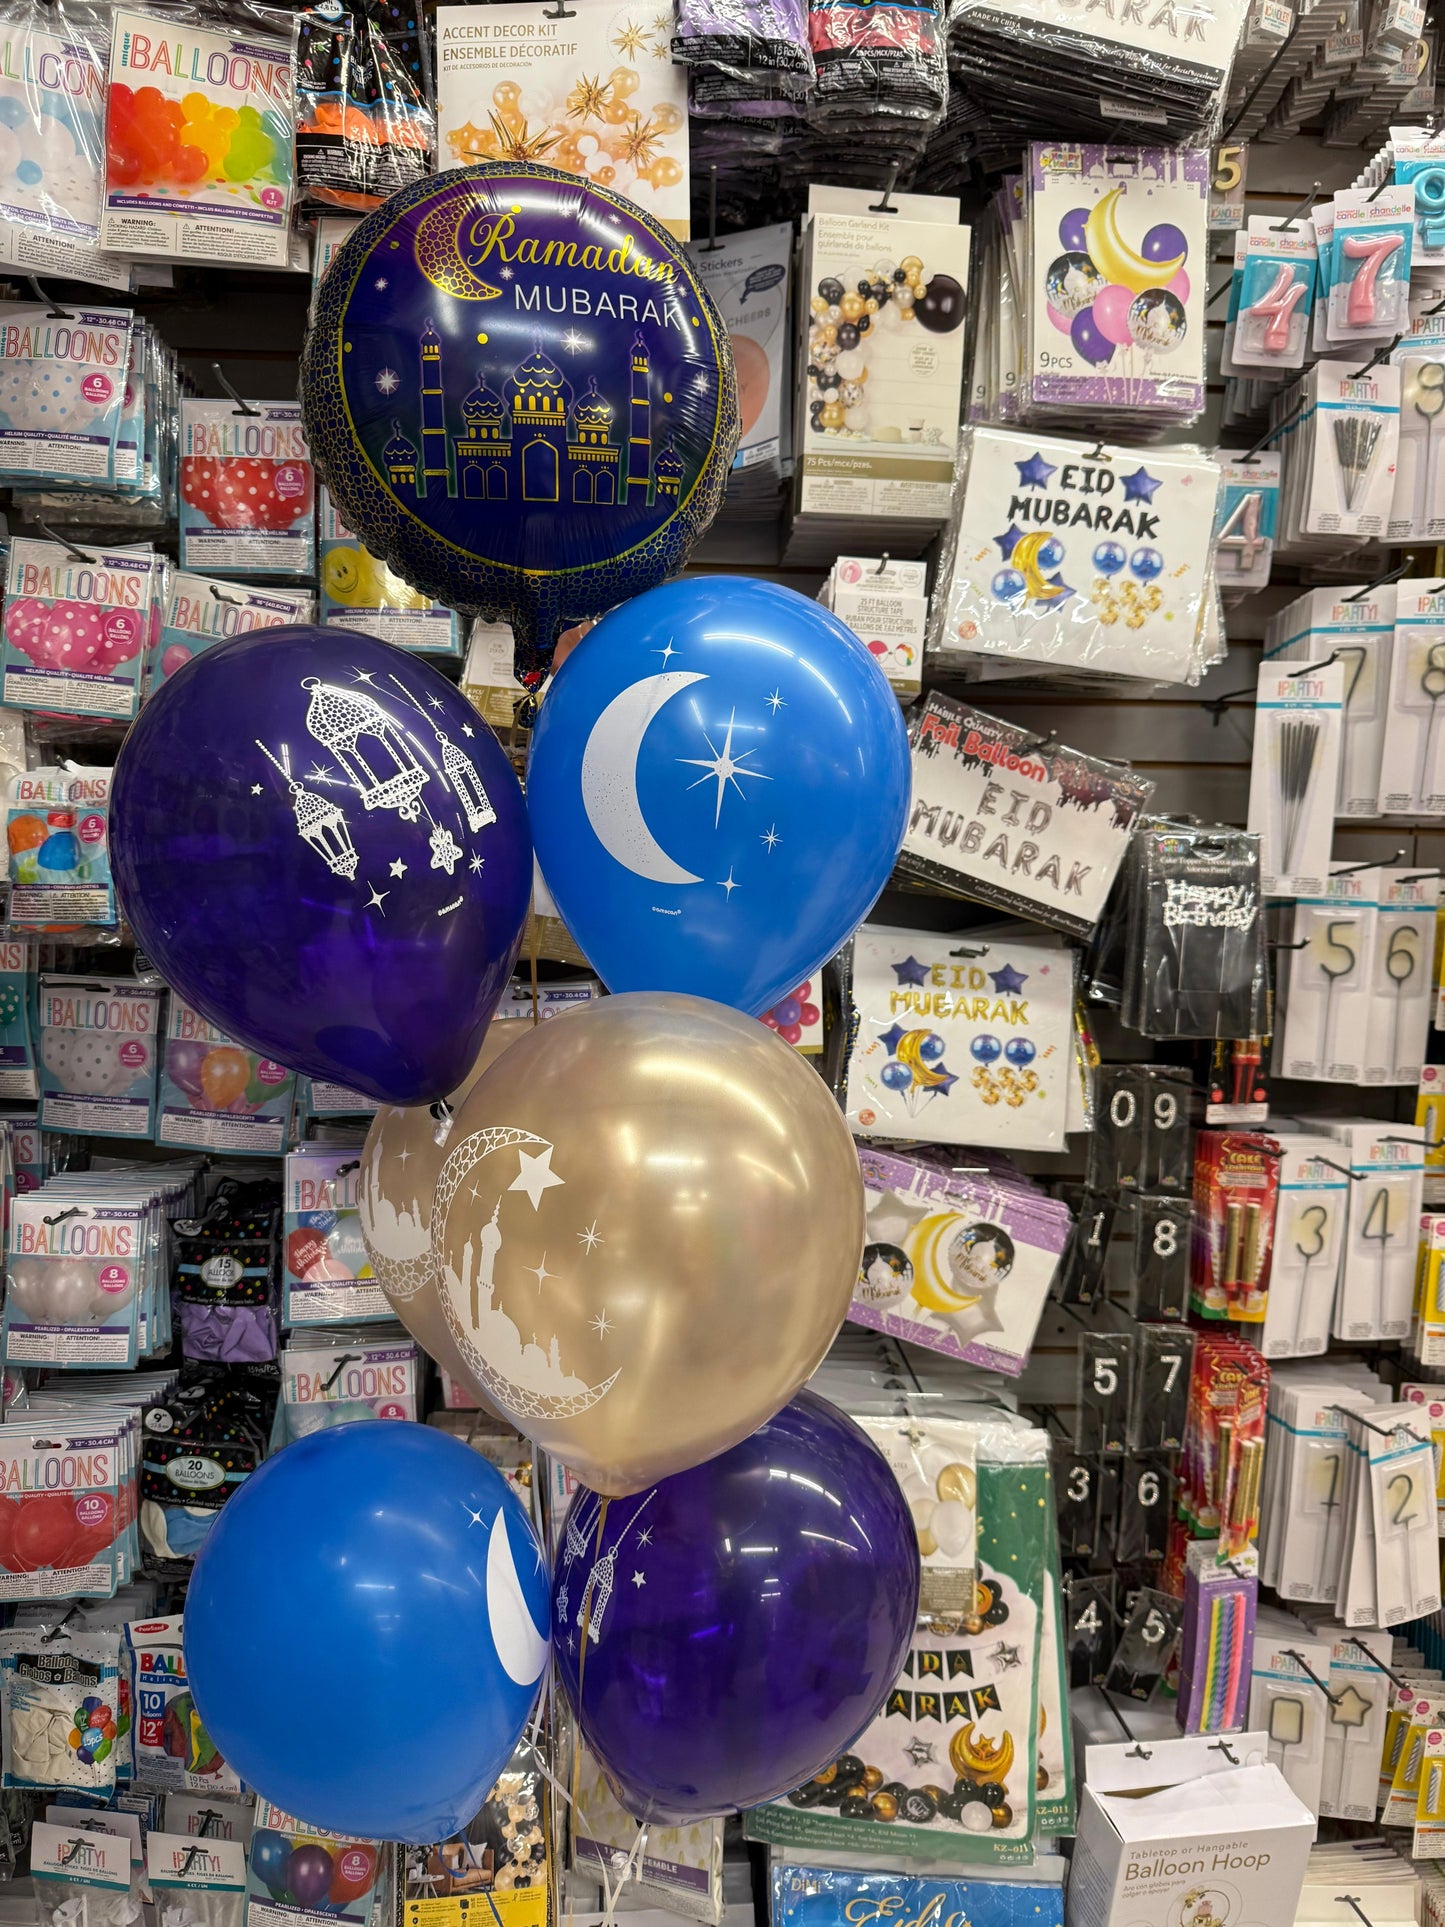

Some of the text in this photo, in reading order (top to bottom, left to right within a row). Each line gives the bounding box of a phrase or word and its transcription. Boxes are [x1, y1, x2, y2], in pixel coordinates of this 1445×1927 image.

[972, 10, 1021, 29] MADE IN CHINA
[443, 24, 558, 40] ACCENT DECOR KIT
[121, 31, 131, 67] unique
[443, 43, 578, 61] ENSEMBLE DÉCORATIF
[130, 33, 292, 101] BALLOONS
[1215, 147, 1242, 191] 5
[269, 192, 275, 200] 1
[1369, 205, 1412, 214] chandelle
[195, 224, 234, 234] ATTENTION!
[819, 218, 847, 227] Balloon
[848, 220, 876, 230] Garland
[33, 235, 75, 249] ATTENTION!
[466, 205, 680, 284] Ramadan
[818, 230, 874, 244] Ensemble pour
[818, 240, 892, 253] guirlande de ballons
[701, 257, 743, 273] Stickers
[1344, 235, 1405, 323] 7
[515, 284, 681, 331] MUBARAK
[728, 307, 771, 328] CHEERS
[6, 326, 119, 365] BALLOONS
[94, 378, 102, 388] 6
[24, 431, 44, 439] QUALITY
[193, 424, 306, 458] BALLOONS
[807, 458, 816, 466] 75
[285, 472, 294, 482] 6
[1060, 464, 1116, 497] EID
[1007, 495, 1161, 540] MUBARAK
[1217, 494, 1264, 568] 4
[23, 564, 140, 606] BALLOONS
[857, 606, 904, 616] STRUCTURE TAPE
[877, 599, 902, 608] BALLOON
[116, 619, 125, 628] 6
[882, 618, 914, 627] STRUCTURE
[46, 670, 68, 678] QUALITY
[920, 712, 1046, 783] Foil Balloon
[976, 781, 1052, 837] EID
[89, 819, 96, 828] 6
[909, 799, 1094, 897] MUBARAK
[1165, 878, 1247, 909] Happy
[1319, 921, 1356, 980] 5
[1386, 925, 1419, 984] 6
[931, 963, 987, 990] EID
[52, 998, 150, 1032] BALLOONS
[890, 990, 1029, 1026] MUBARAK
[130, 1044, 137, 1054] 6
[1154, 1092, 1178, 1130] 9
[1362, 1188, 1395, 1239] 4
[1088, 1211, 1106, 1246] 1
[1296, 1206, 1328, 1258] 3
[22, 1223, 132, 1256] BALLOONS
[1153, 1219, 1178, 1257] 8
[110, 1269, 118, 1279] 8
[1093, 1358, 1119, 1396] 5
[1160, 1355, 1182, 1393] 7
[299, 1366, 406, 1402] BALLOONS
[154, 1413, 168, 1422] 9"
[388, 1407, 397, 1416] 8
[188, 1460, 202, 1470] 20
[175, 1469, 214, 1480] BALLOONS
[1067, 1466, 1090, 1502] 3
[1138, 1472, 1160, 1506] 6
[84, 1500, 100, 1510] 10
[1387, 1474, 1418, 1525] 2
[52, 1566, 90, 1577] ATTENTION!
[1074, 1600, 1102, 1634] 4
[1141, 1608, 1166, 1643] 5
[38, 1654, 80, 1670] Balloons
[20, 1664, 52, 1682] Globos
[144, 1694, 161, 1710] 10
[890, 1689, 995, 1714] ARAK
[144, 1720, 164, 1738] 12"
[143, 1736, 158, 1744] round
[190, 1782, 199, 1790] 12
[1130, 1848, 1177, 1860] Tabletop
[1197, 1841, 1249, 1854] Hangable
[352, 1856, 360, 1866] 8
[644, 1857, 678, 1874] SEMBLE
[1125, 1853, 1271, 1882] Balloon Hoop
[1172, 1879, 1186, 1887] para
[1122, 1890, 1142, 1898] colgar
[260, 1906, 289, 1918] WARNING:
[275, 1902, 338, 1919] PEARLIZED OPALESCENTS
[305, 1917, 338, 1926] ATTENTION!
